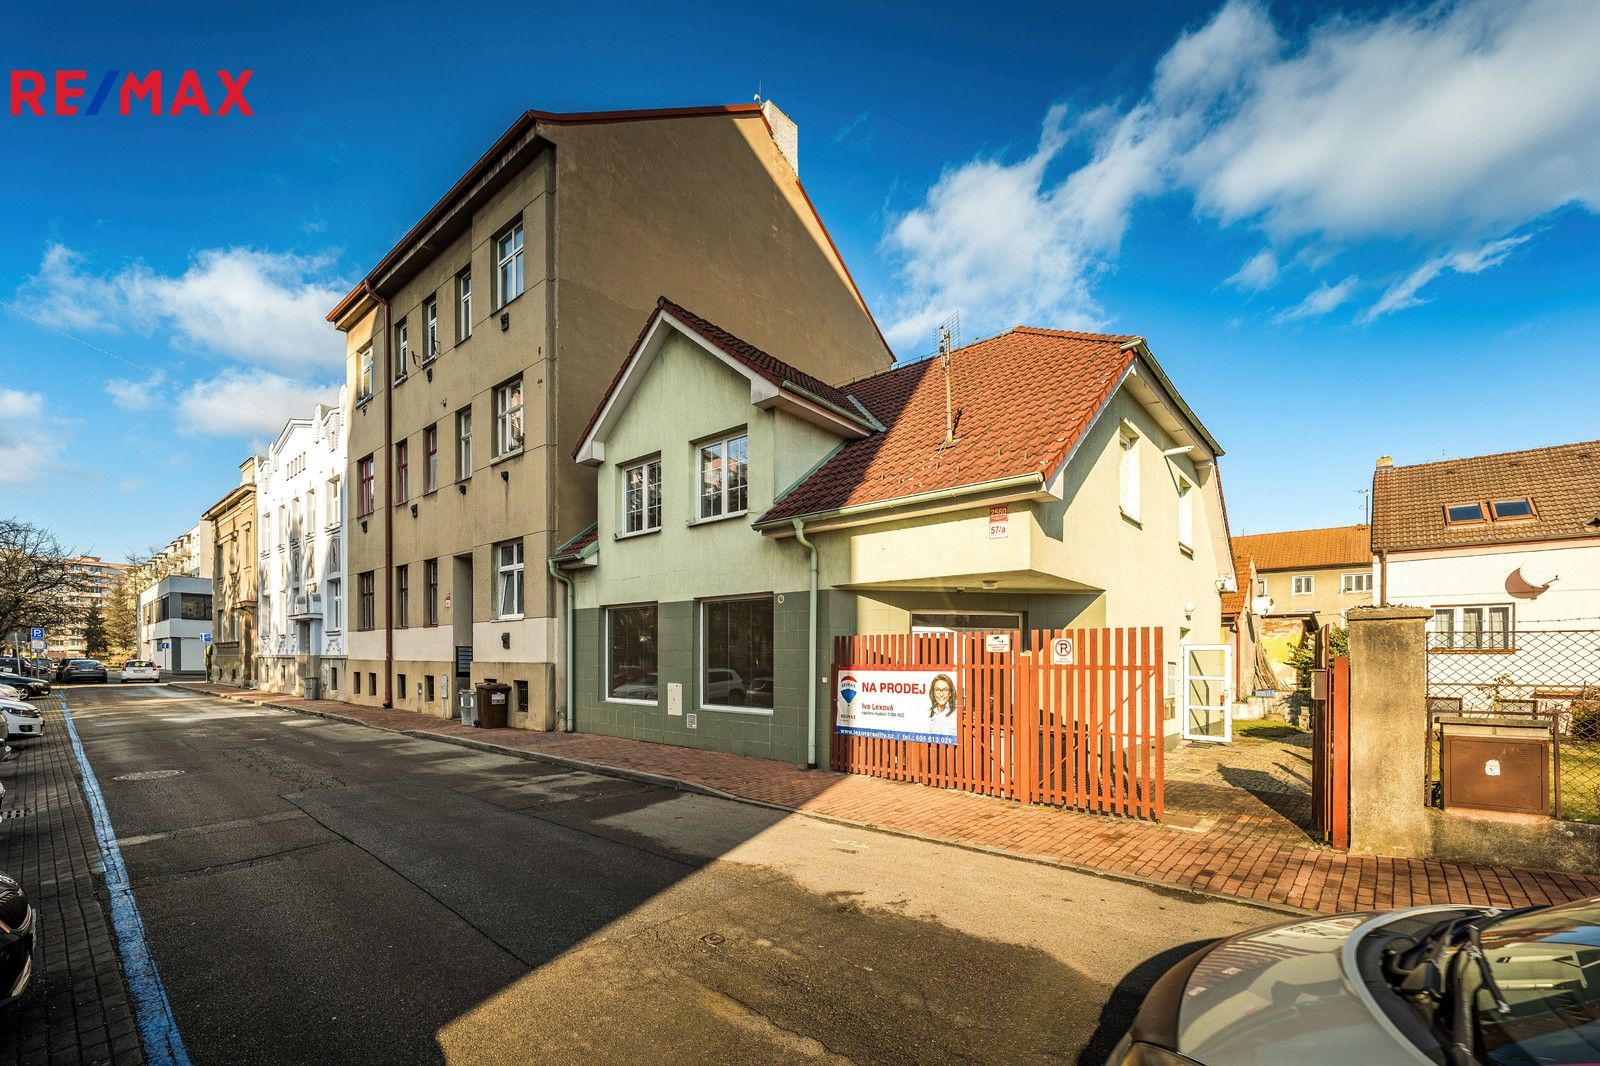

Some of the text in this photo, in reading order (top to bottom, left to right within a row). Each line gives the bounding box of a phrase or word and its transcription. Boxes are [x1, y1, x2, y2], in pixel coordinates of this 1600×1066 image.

[862, 682, 926, 695] NA PRODEJ
[872, 703, 894, 711] Lexová
